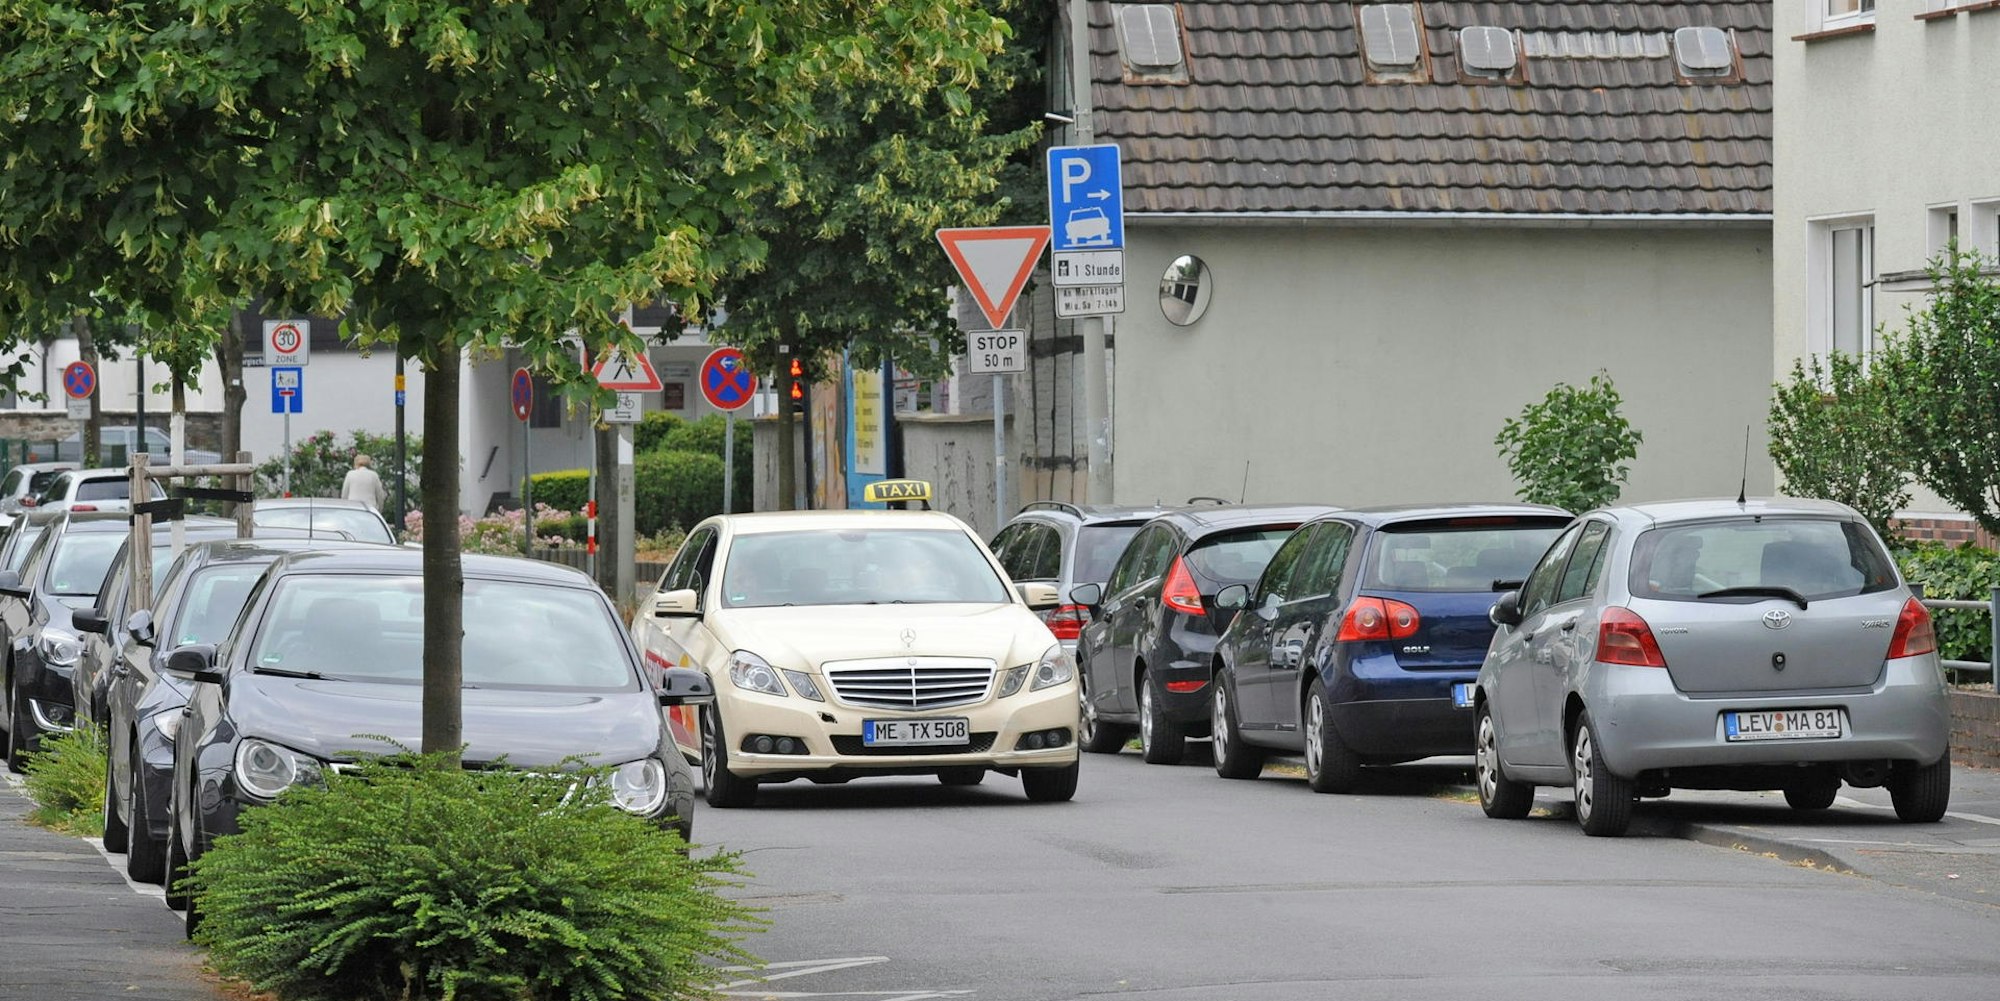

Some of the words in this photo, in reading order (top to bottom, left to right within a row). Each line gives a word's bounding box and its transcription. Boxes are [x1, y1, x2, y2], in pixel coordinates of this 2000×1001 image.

[1061, 157, 1092, 204] P
[1074, 264, 1079, 277] 1
[1084, 263, 1120, 277] Stunde
[278, 330, 295, 346] 30
[977, 336, 1018, 350] STOP
[276, 355, 297, 363] ZONE
[984, 353, 999, 367] 50
[1002, 356, 1013, 367] m
[877, 483, 922, 497] TAXI
[1659, 626, 1688, 634] TOYOTA
[1403, 645, 1430, 653] GOLF
[1737, 713, 1774, 733] LEV
[1786, 712, 1811, 731] MA
[1815, 711, 1838, 730] 81
[875, 723, 898, 740] ME
[908, 722, 930, 739] TX
[934, 721, 965, 739] 508
